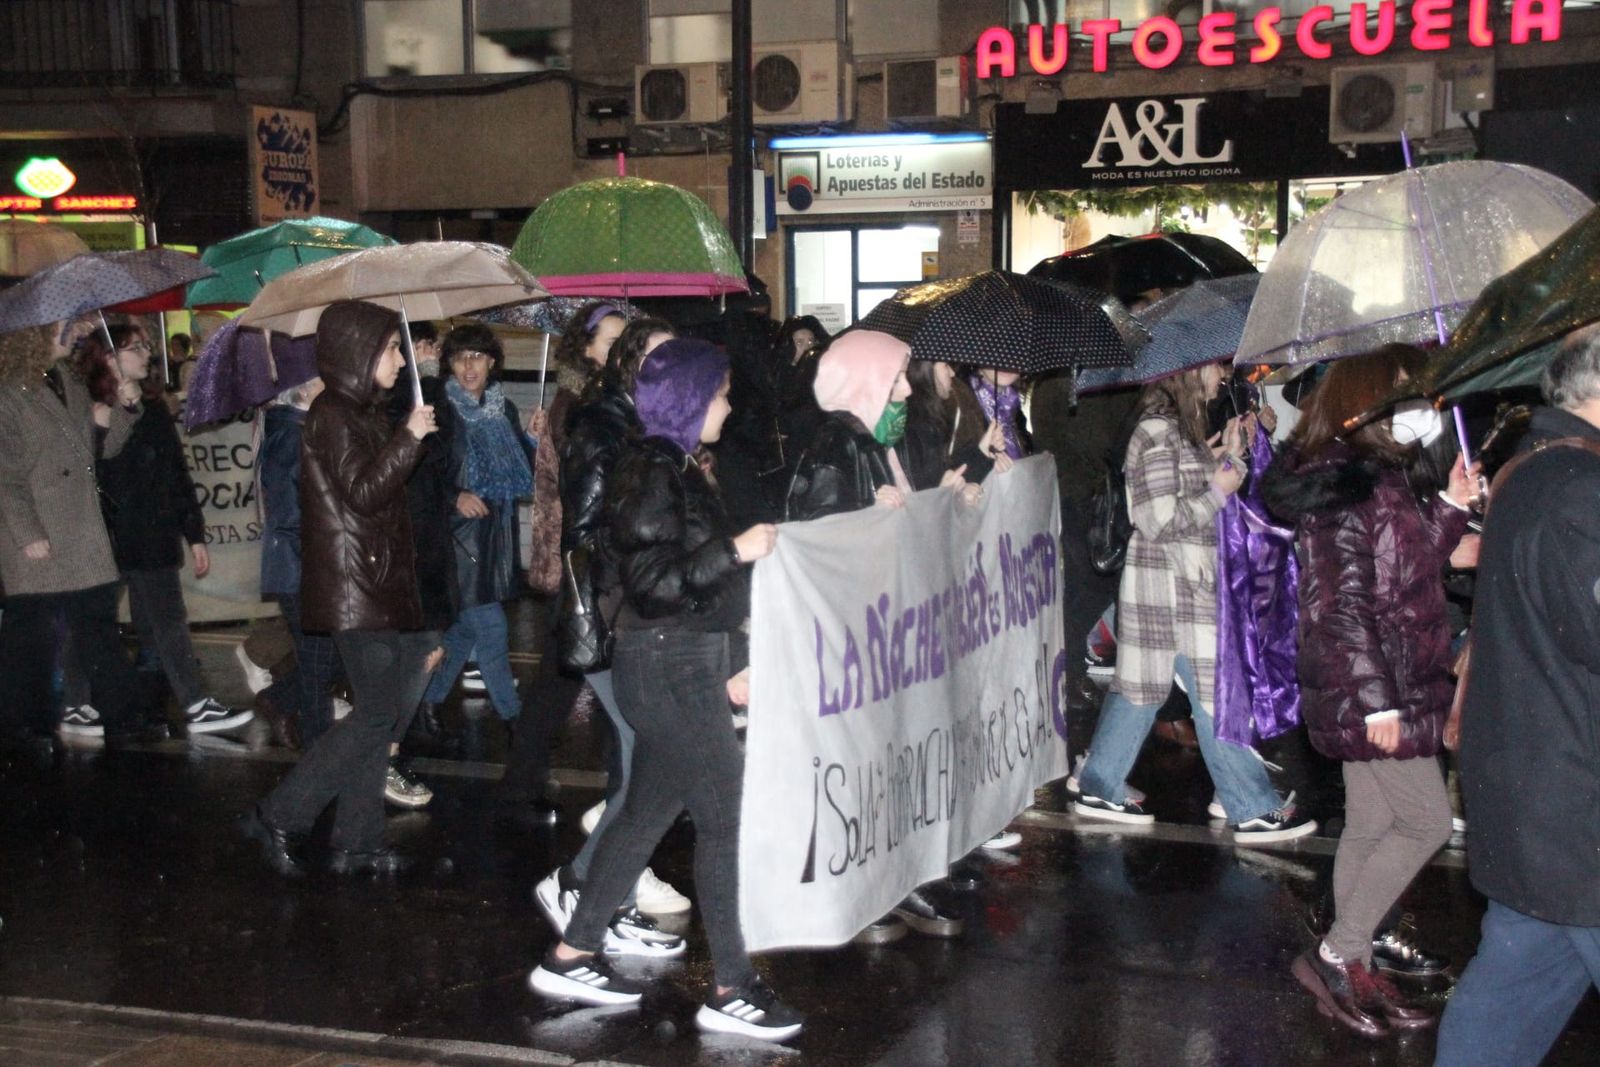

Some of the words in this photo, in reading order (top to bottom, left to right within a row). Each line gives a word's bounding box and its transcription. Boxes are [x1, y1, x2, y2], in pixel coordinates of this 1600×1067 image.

[976, 0, 1563, 79] AUTOESCUELA
[1082, 98, 1233, 168] A&L
[894, 155, 903, 171] y
[1091, 171, 1124, 180] MODA
[1127, 171, 1142, 179] ES
[1144, 168, 1197, 178] NUESTRO
[1199, 167, 1241, 176] IDIOMA
[827, 175, 898, 196] Apuestas
[902, 172, 926, 189] del
[931, 170, 985, 188] Estado
[908, 199, 969, 208] Administración
[182, 443, 254, 472] EREC
[204, 524, 241, 545] STA
[814, 615, 864, 718] LA
[866, 592, 945, 703] NOCHE
